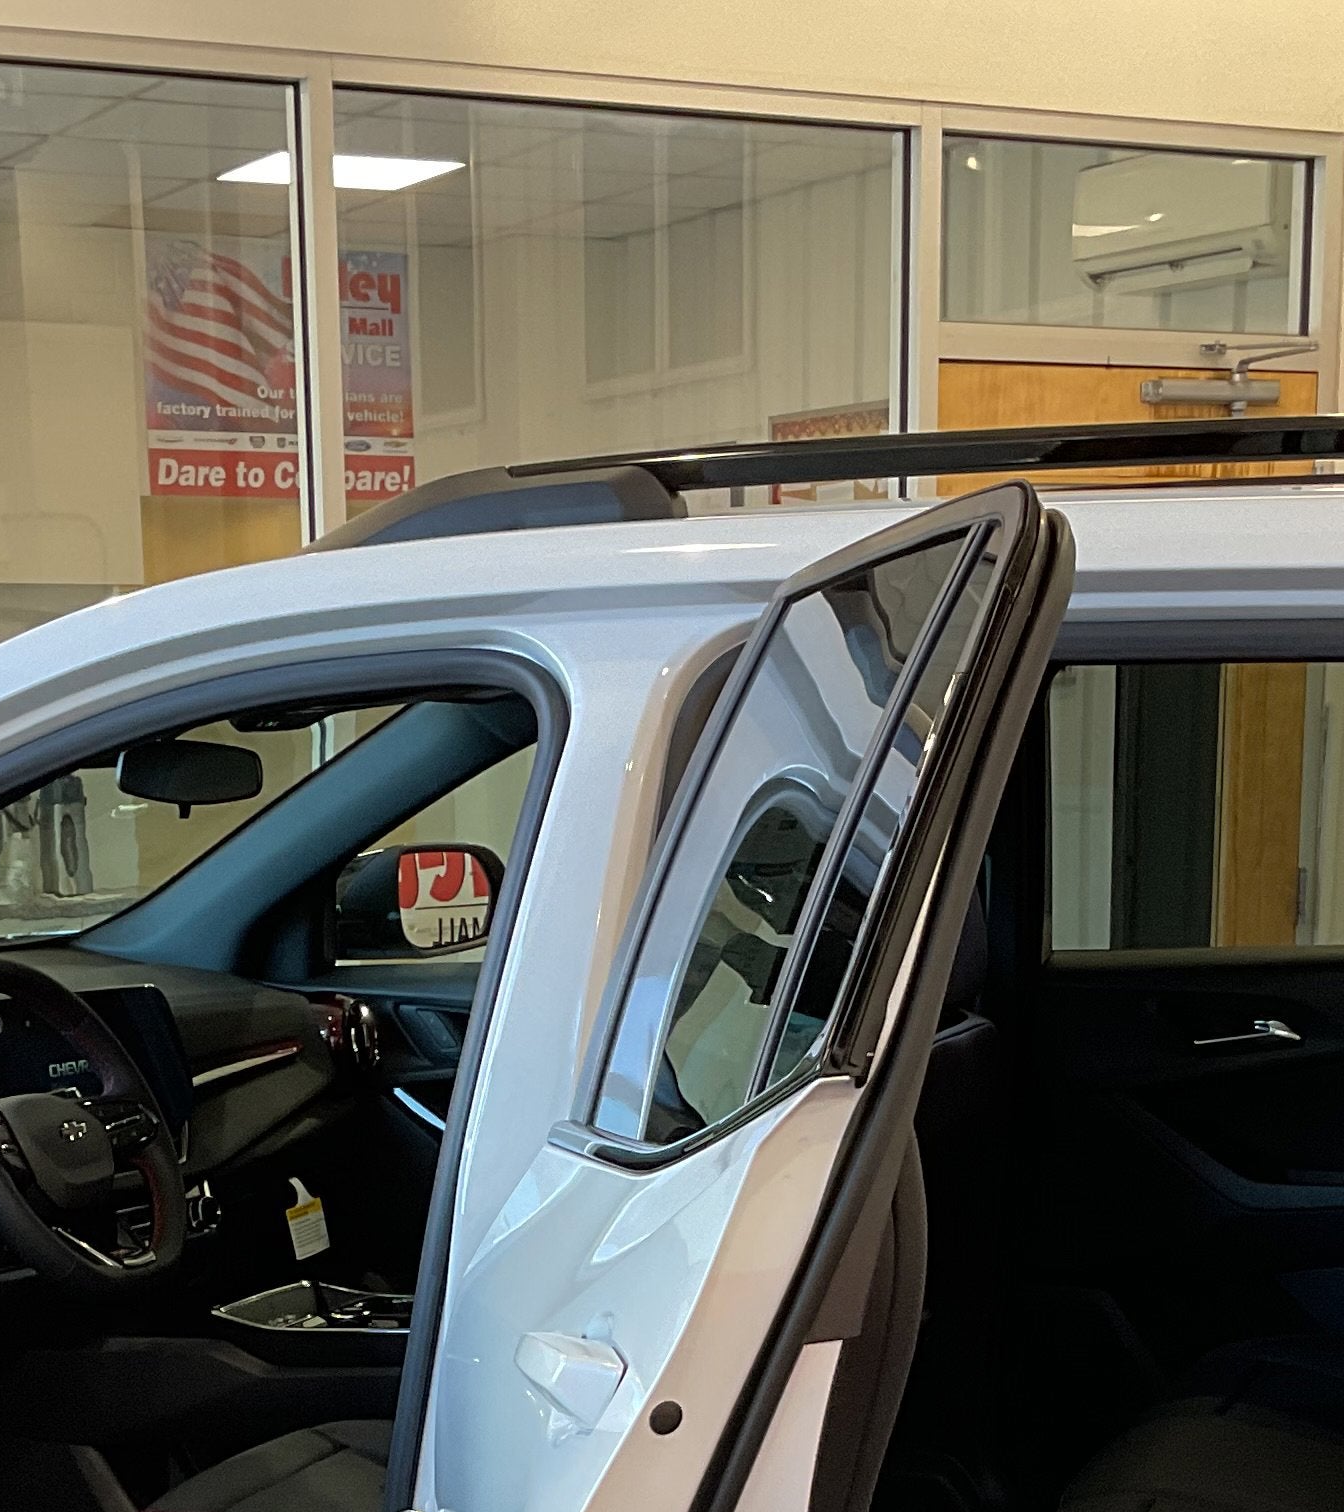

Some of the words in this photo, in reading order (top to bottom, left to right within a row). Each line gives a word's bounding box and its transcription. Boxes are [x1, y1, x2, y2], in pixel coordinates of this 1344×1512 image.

[348, 316, 394, 337] Mall
[257, 385, 285, 399] Our
[380, 393, 403, 403] are
[157, 401, 211, 418] factory
[216, 404, 270, 418] trained
[272, 405, 295, 423] for
[347, 409, 404, 423] vehicle!
[158, 458, 226, 487] Dare
[236, 461, 265, 488] to
[274, 461, 411, 492] Cpare!
